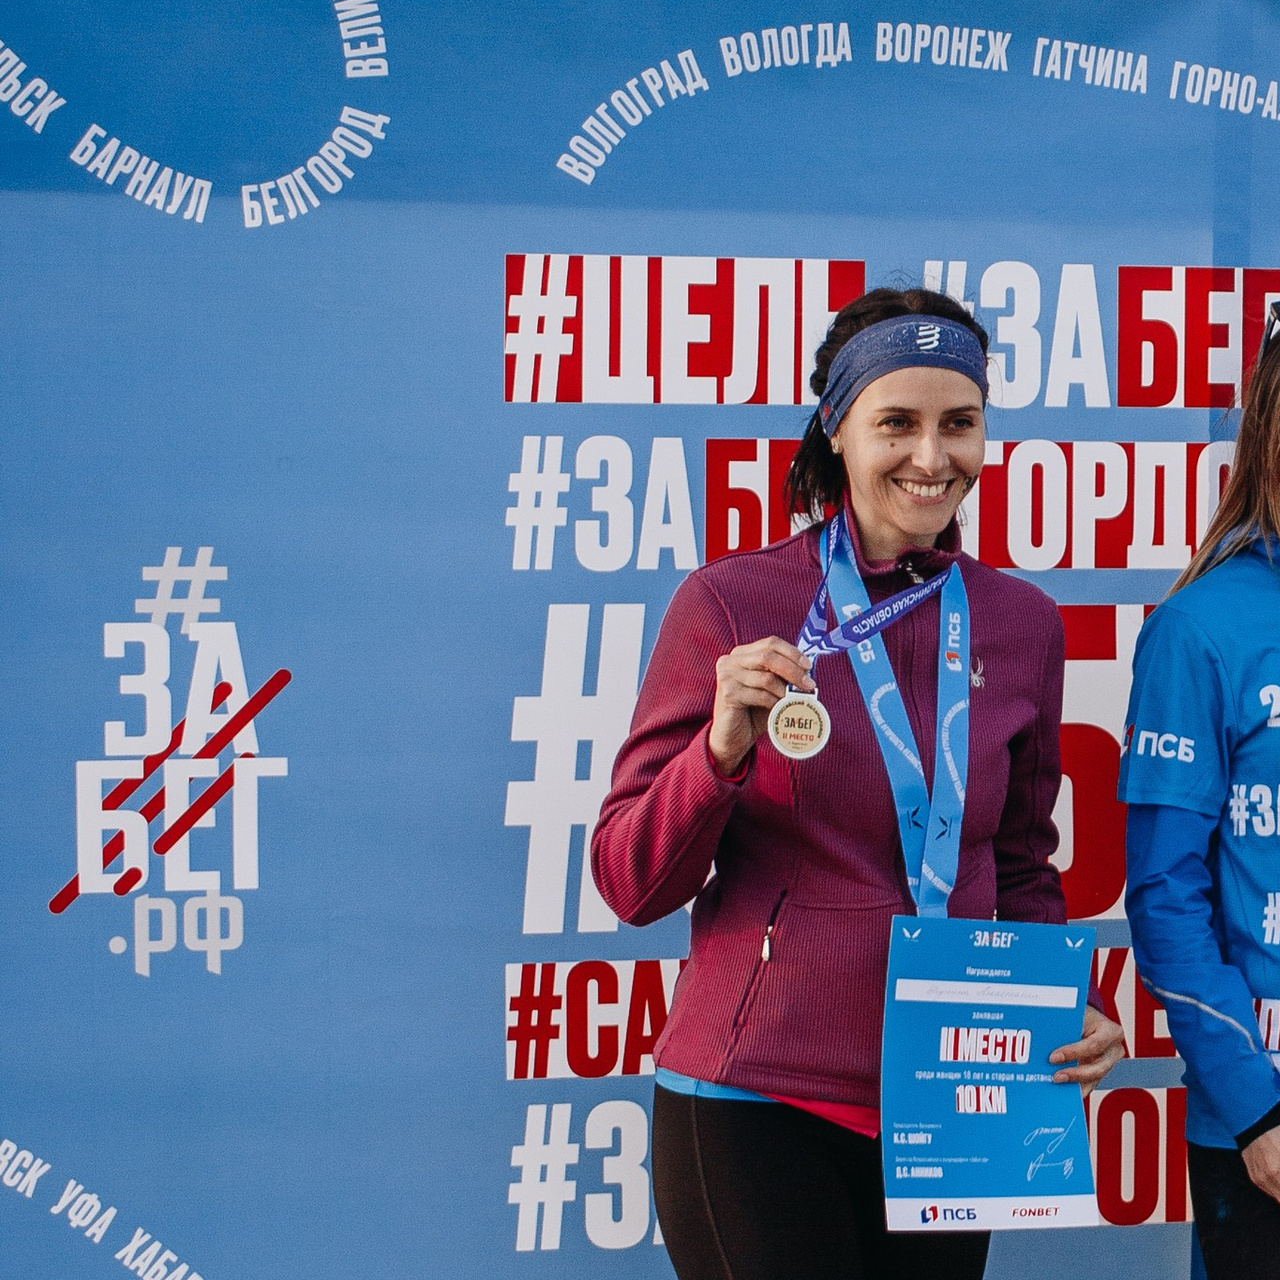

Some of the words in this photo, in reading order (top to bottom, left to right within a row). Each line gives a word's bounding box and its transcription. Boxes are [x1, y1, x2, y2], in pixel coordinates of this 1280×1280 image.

[556, 49, 709, 185] ВОЛГОГРАД
[719, 22, 852, 77] ВОЛОГДА
[875, 22, 1012, 72] ВОРОНЕЖ
[1032, 37, 1148, 94] ГАТЧИНА
[69, 123, 213, 223] БАРНАУЛ
[241, 105, 390, 228] БЕЛГОРОД
[852, 605, 893, 636] ОБЛАСТЬ
[947, 612, 961, 648] ПСБ
[857, 638, 876, 664] СБ
[104, 621, 259, 756] ЗА
[789, 732, 815, 742] МЕСТО
[1137, 729, 1195, 763] ПСБ
[76, 756, 288, 894] БЕГ
[966, 966, 1011, 977] Награждается
[958, 1027, 1032, 1064] МЕСТО
[915, 1070, 935, 1080] среди
[972, 1072, 984, 1081] лет
[1016, 1074, 1024, 1082] на
[956, 1084, 977, 1114] 10
[979, 1086, 1007, 1114] КМ
[50, 1179, 118, 1244] УФА
[943, 1208, 977, 1221] ПСБ
[1012, 1207, 1060, 1218] FONBET
